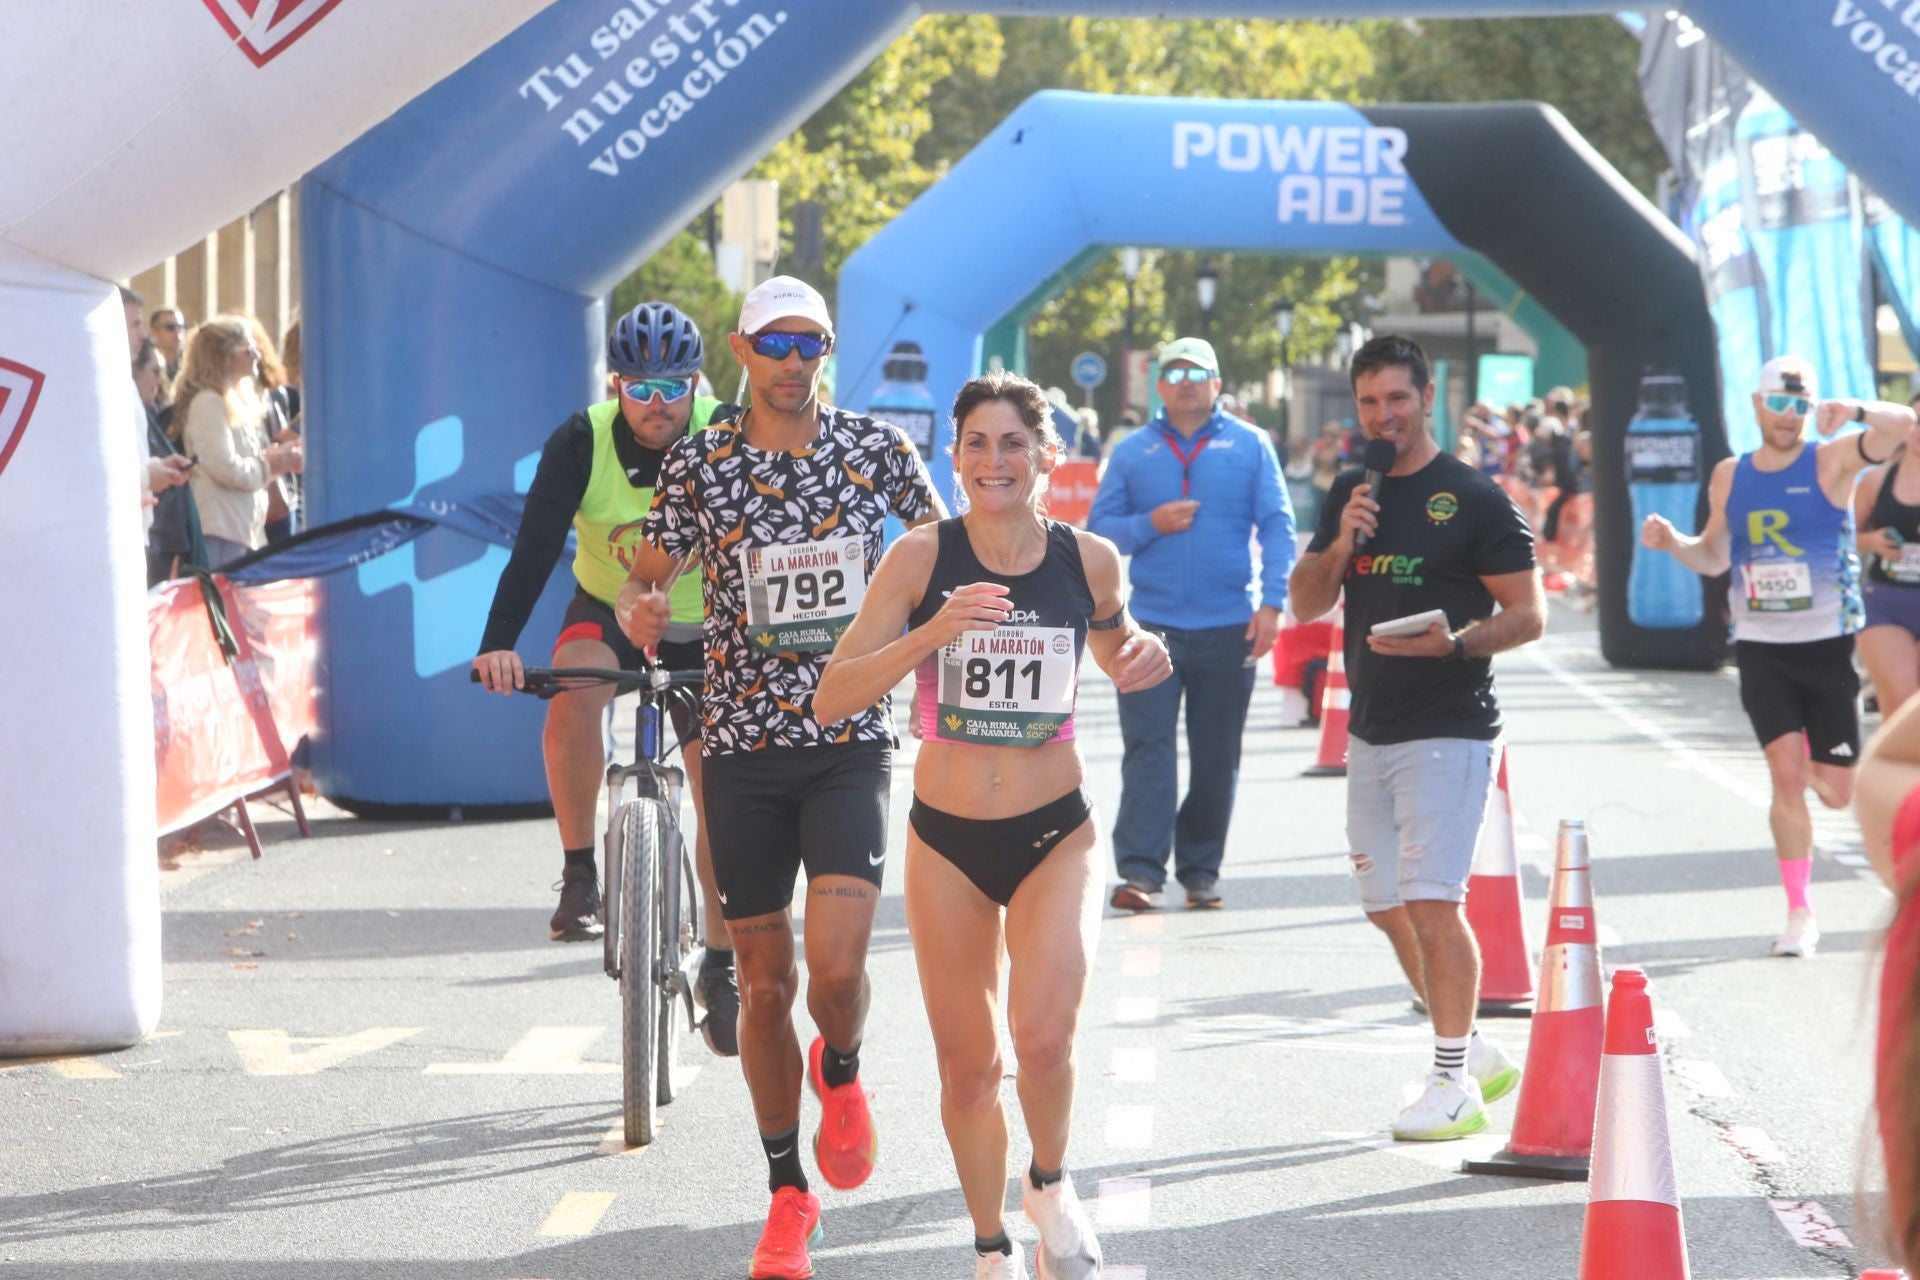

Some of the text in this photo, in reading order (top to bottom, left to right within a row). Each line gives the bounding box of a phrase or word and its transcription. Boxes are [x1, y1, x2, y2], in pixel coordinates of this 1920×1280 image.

[519, 0, 672, 112] Tu sal
[1831, 0, 1920, 105] voca
[561, 0, 741, 146] nuestr
[588, 11, 788, 177] vocación.
[1172, 121, 1409, 175] POWER
[1277, 174, 1408, 226] ADE
[1747, 509, 1805, 556] R
[771, 558, 785, 572] LA
[788, 549, 839, 570] MARATÓN
[1346, 555, 1424, 577] errer
[767, 569, 847, 613] 792
[1757, 578, 1797, 593] 1450
[793, 610, 827, 620] HECTOR
[779, 628, 828, 639] CAJA RURAL
[780, 638, 791, 646] DE
[793, 635, 832, 645] NAVARRA
[971, 638, 985, 653] LA
[990, 637, 1045, 655] MARATÓN
[965, 658, 1042, 700] 811
[989, 701, 1019, 709] ESTER
[966, 728, 1023, 738] DE NAVARRA
[967, 720, 1019, 730] CAJA RURAL
[1026, 722, 1061, 731] ACCIÓN
